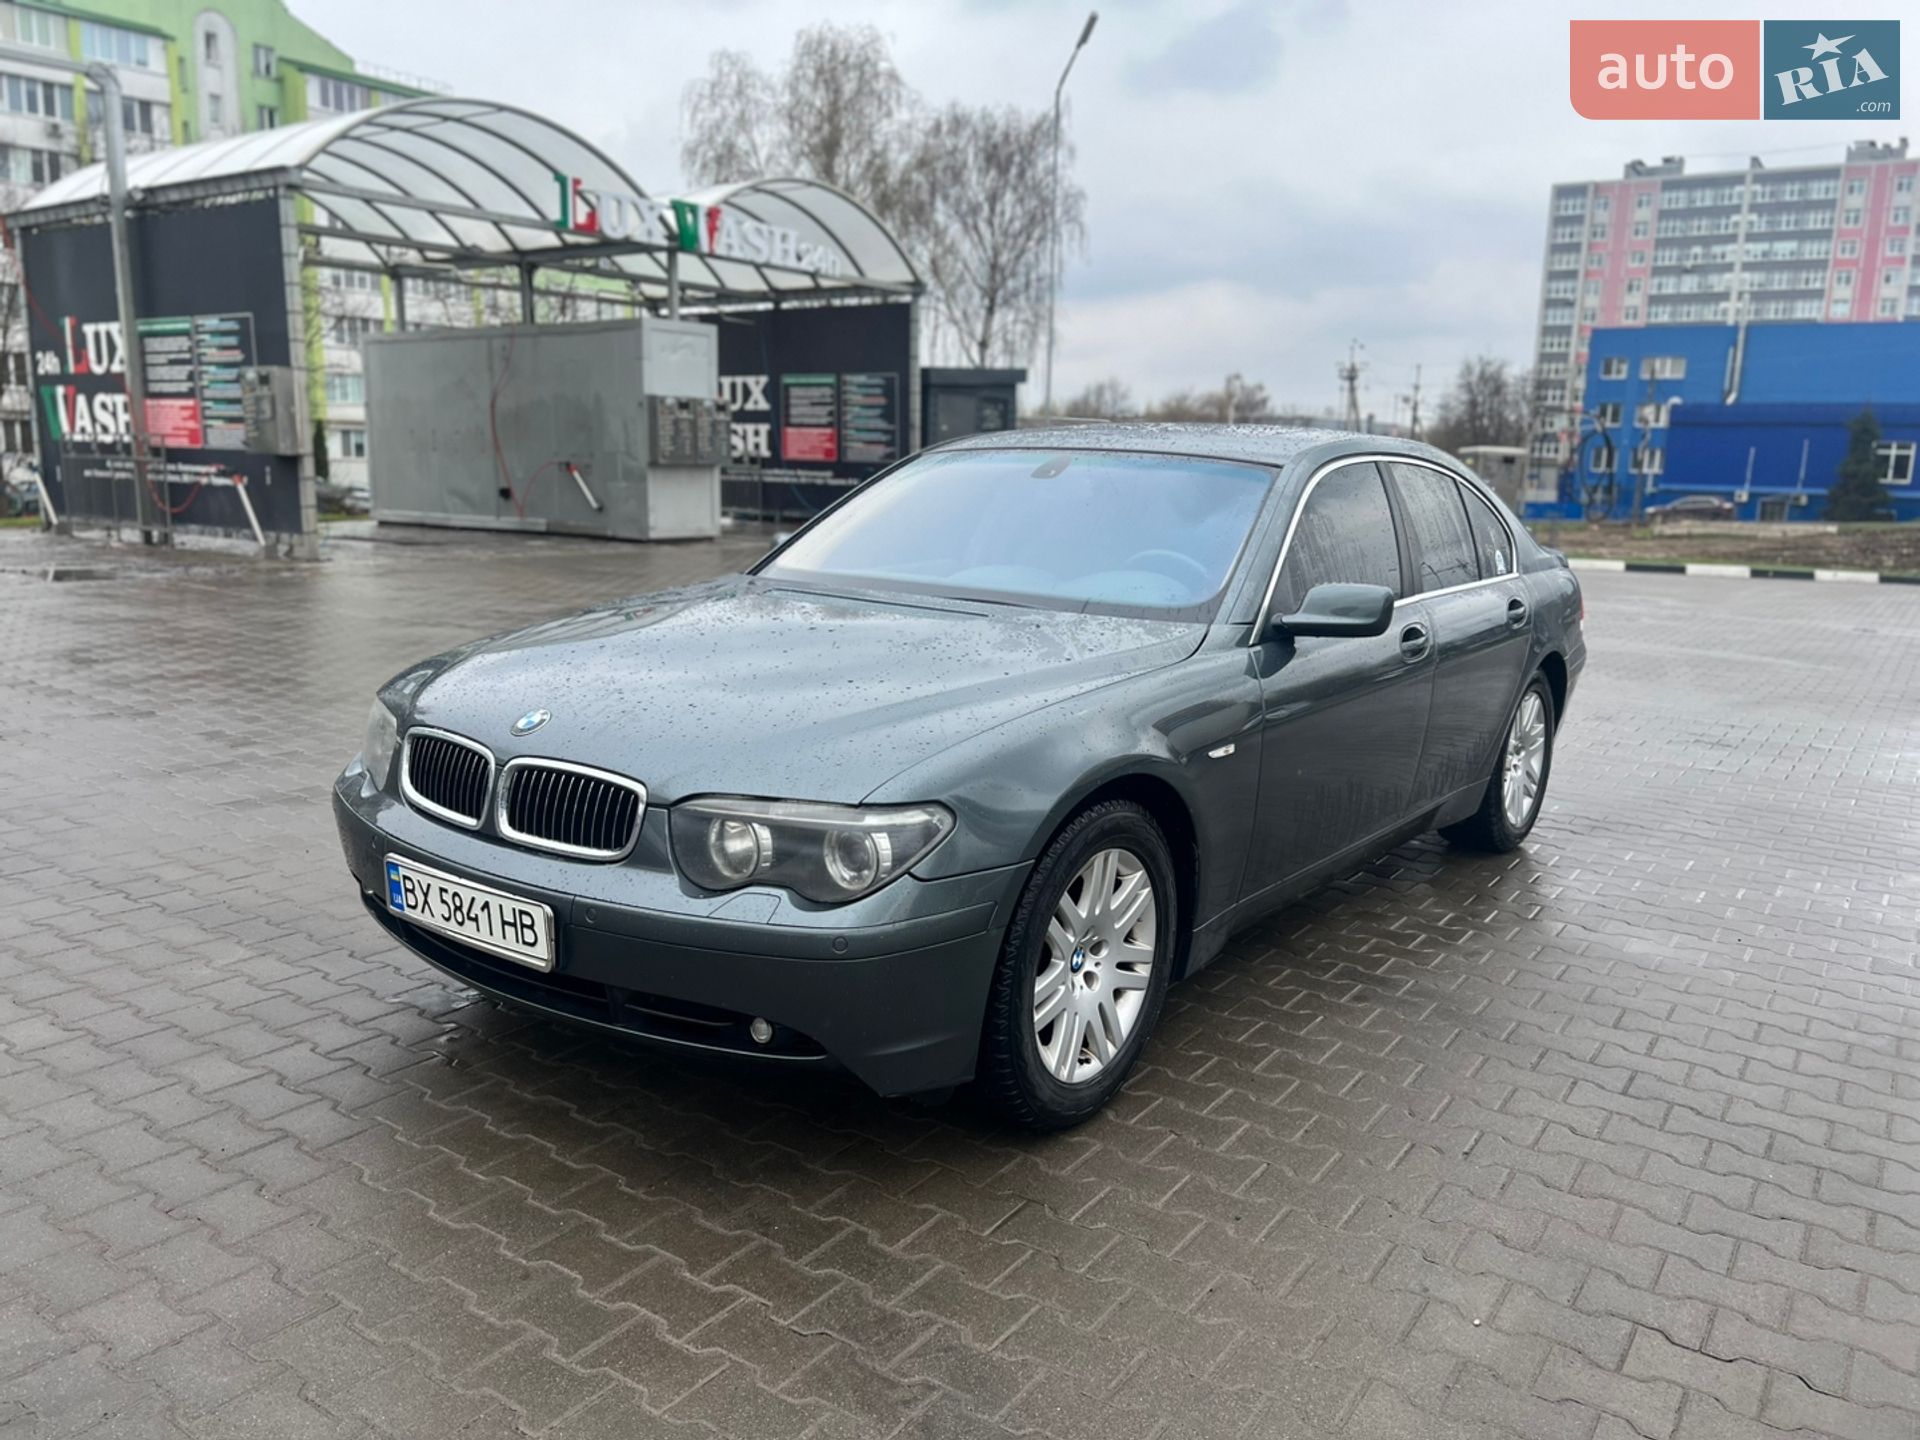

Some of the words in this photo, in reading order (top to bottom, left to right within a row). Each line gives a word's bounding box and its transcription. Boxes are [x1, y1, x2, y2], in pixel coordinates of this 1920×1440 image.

[554, 174, 672, 245] LUX
[669, 199, 798, 266] WASH
[36, 350, 61, 375] 24h
[719, 375, 771, 411] UX
[730, 423, 772, 459] SH
[393, 893, 403, 903] UA
[402, 875, 435, 918] BX
[438, 886, 494, 937] 5841
[499, 903, 539, 948] HB
